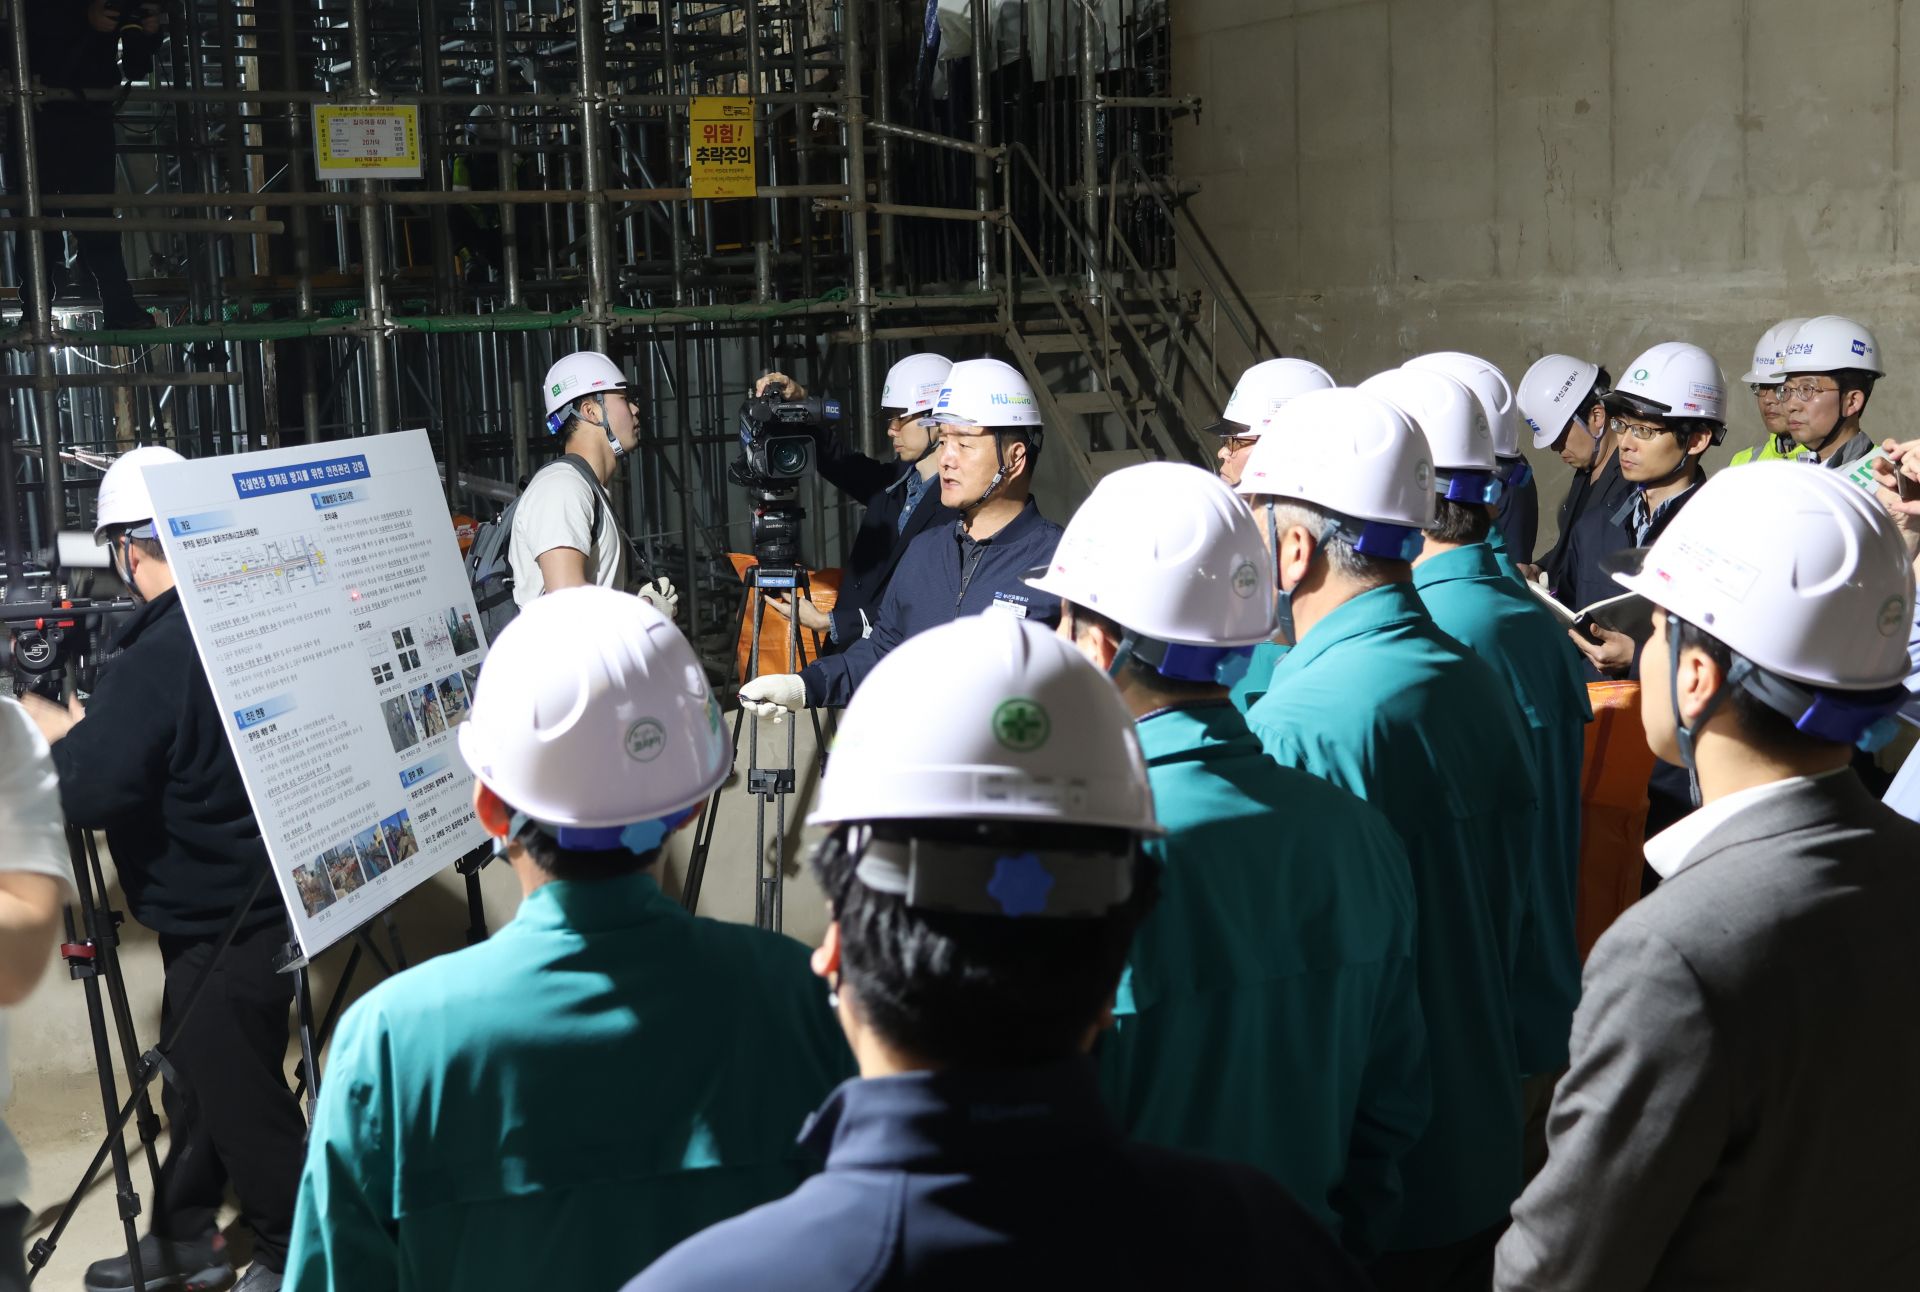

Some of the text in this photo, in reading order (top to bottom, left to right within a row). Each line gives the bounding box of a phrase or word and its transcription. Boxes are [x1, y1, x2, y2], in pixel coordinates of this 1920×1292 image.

[696, 146, 751, 166] 추락주의
[1786, 344, 1814, 355] 산건설
[1553, 370, 1578, 404] 부산교통공사
[238, 460, 365, 492] 건설현장 땅꺼짐 방지를 위한 안전관리 강화
[244, 710, 256, 723] 추진
